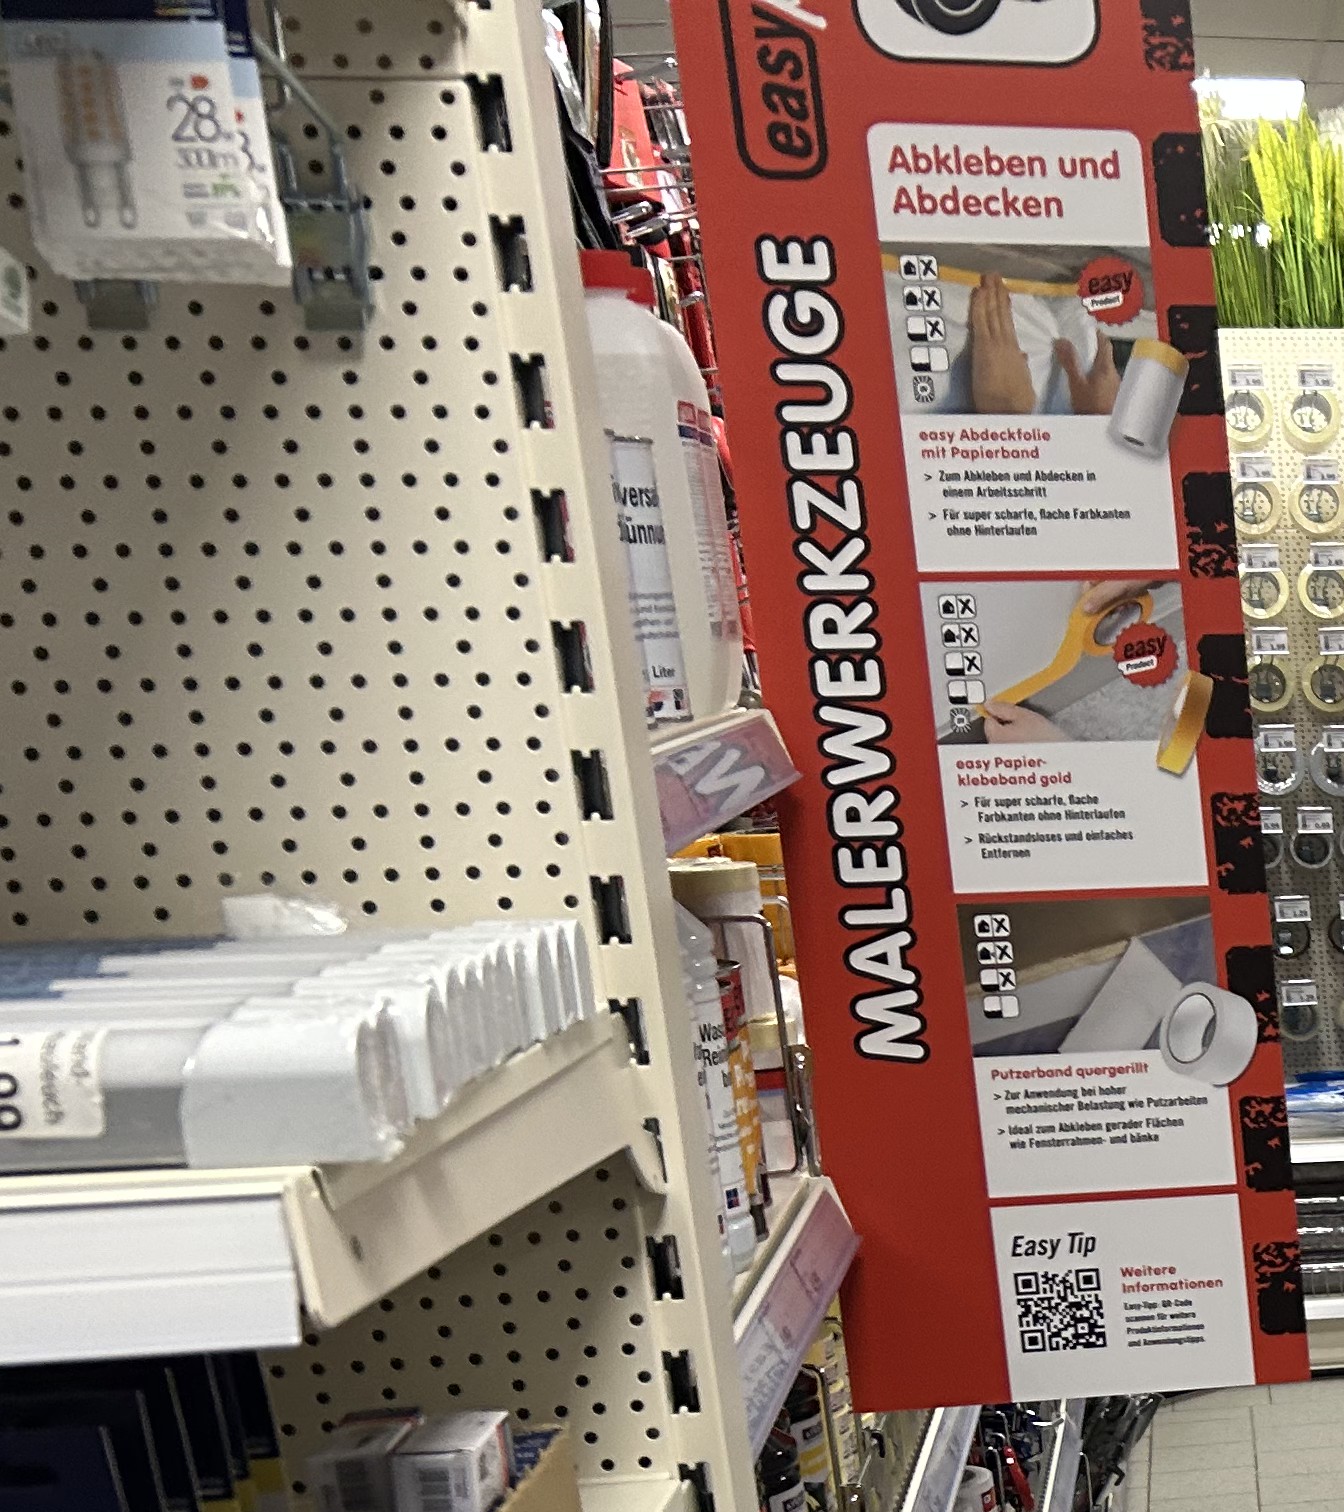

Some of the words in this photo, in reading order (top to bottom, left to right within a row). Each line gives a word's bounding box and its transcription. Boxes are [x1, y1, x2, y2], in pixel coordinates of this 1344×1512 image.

[754, 5, 814, 158] easy
[888, 144, 1046, 178] Abkleben
[1058, 150, 1121, 179] und
[893, 186, 1064, 218] Abdecken
[1089, 270, 1133, 294] easy
[919, 429, 954, 444] easy
[960, 428, 1051, 441] Abdeckfolie
[921, 447, 946, 459] mit
[951, 446, 1040, 461] Papierband
[964, 470, 1010, 481] Abkleben
[1013, 471, 1032, 481] und
[1035, 470, 1084, 481] Abdecken
[1087, 471, 1096, 481] in
[963, 510, 991, 522] super
[1073, 508, 1131, 519] Farbkanten
[757, 235, 927, 1061] MALERWERKZEUGE
[1124, 635, 1167, 659] easy
[956, 758, 990, 771] easy
[994, 756, 1047, 770] Papier-
[958, 772, 1036, 786] klebeband
[1040, 771, 1072, 787] gold
[991, 1065, 1072, 1081] Putzerband
[1076, 1063, 1149, 1079] quergerillt
[1011, 1236, 1061, 1259] Easy
[1068, 1232, 1097, 1257] Tip
[1120, 1265, 1176, 1278] Weitere
[1122, 1278, 1223, 1294] Informationen
